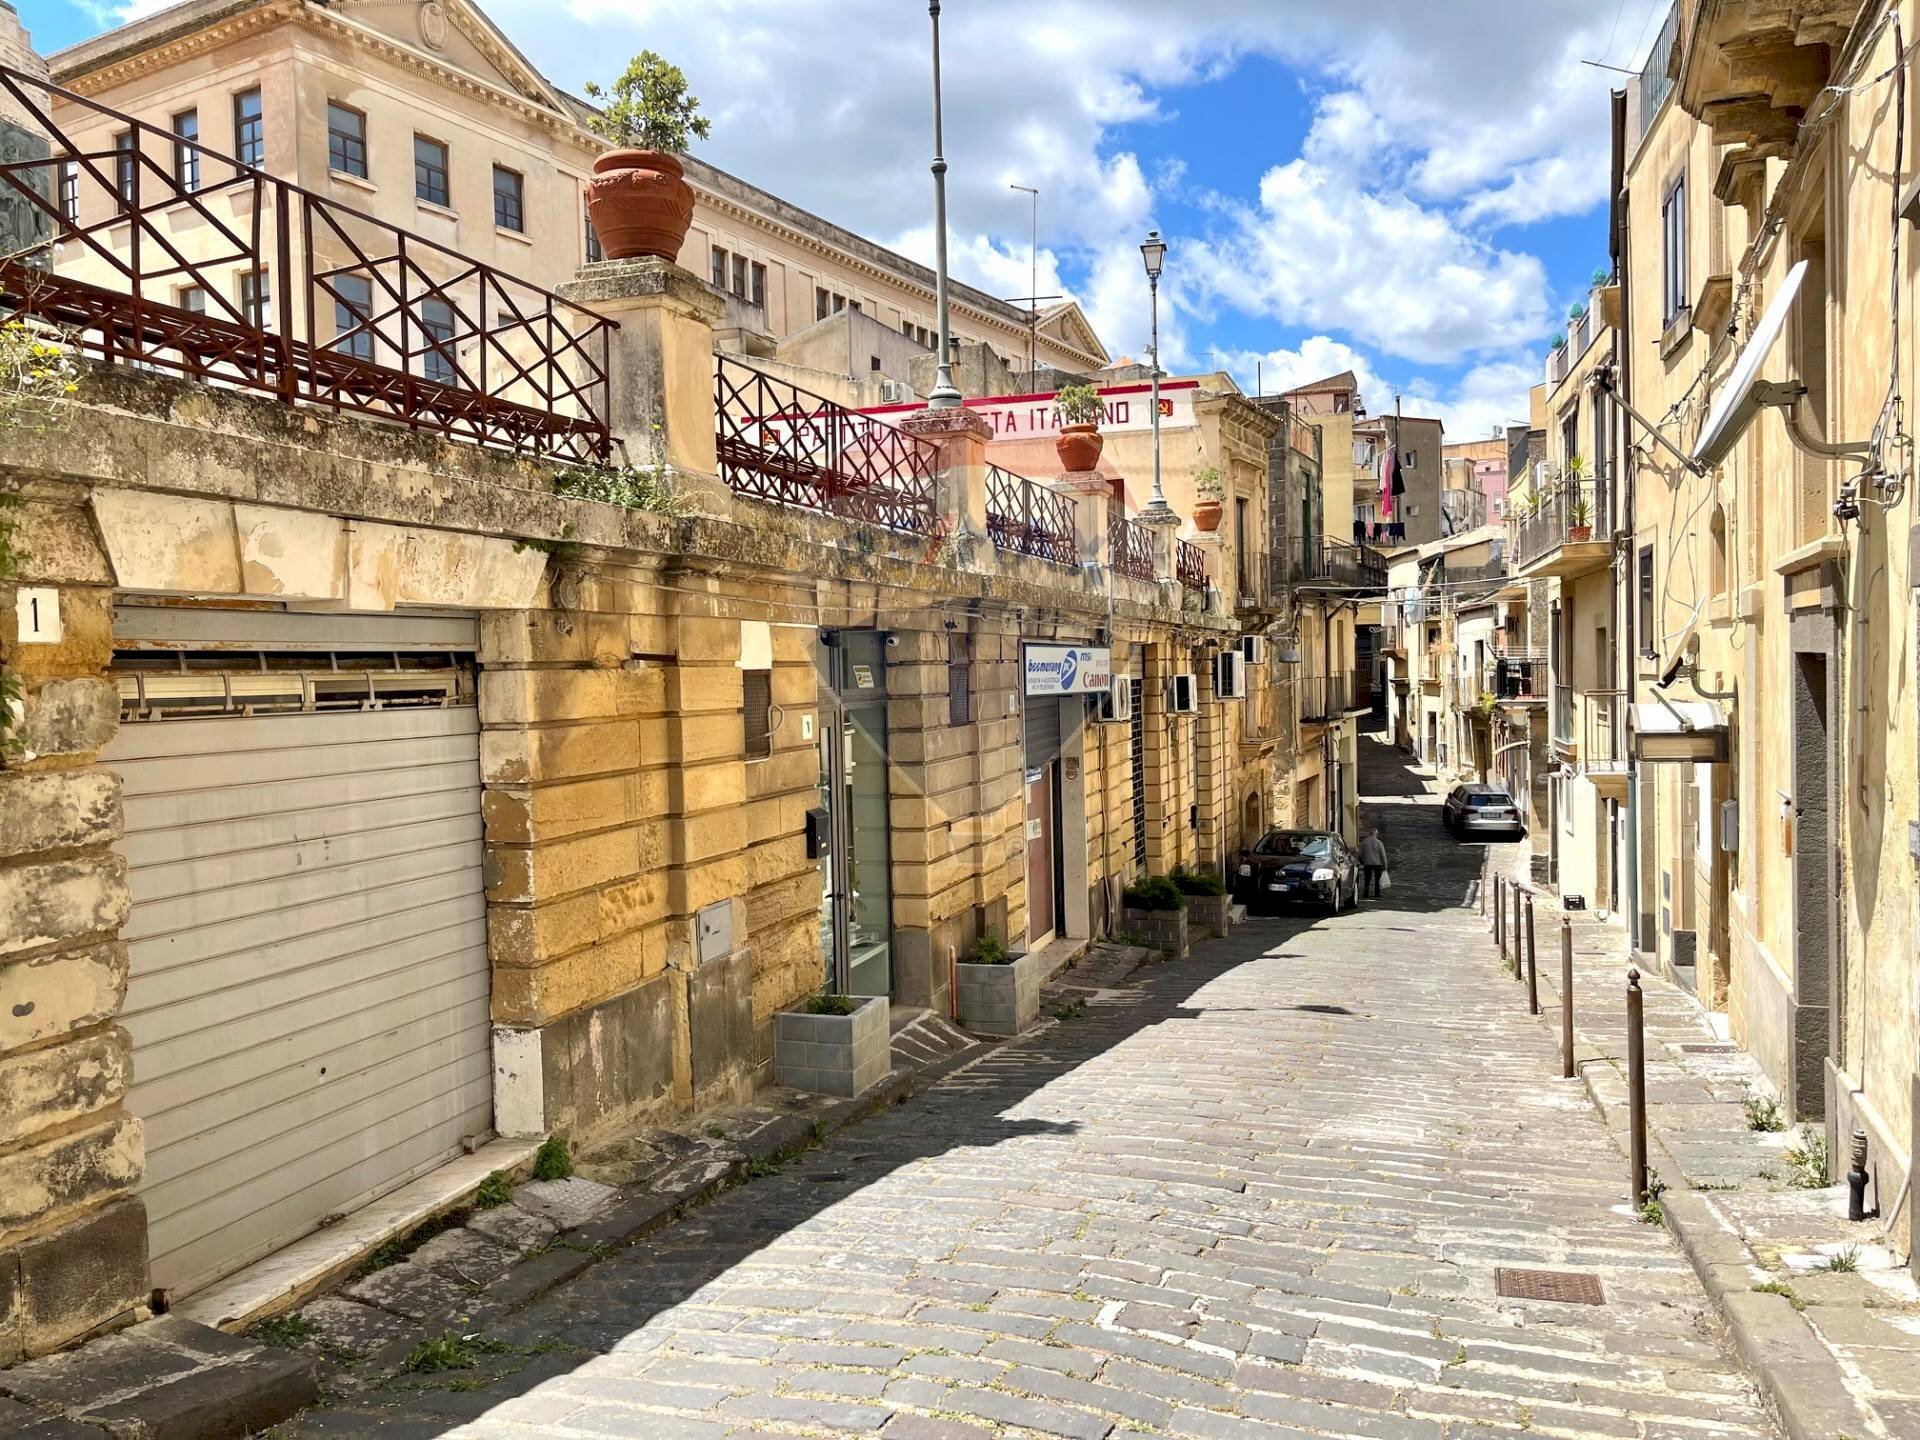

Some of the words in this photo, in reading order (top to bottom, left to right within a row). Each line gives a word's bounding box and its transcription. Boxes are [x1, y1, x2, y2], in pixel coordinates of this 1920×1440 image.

[799, 421, 882, 447] PATITO
[1030, 401, 1129, 430] ITAANO
[31, 597, 39, 632] 1
[1028, 659, 1061, 675] boomerang
[1082, 672, 1109, 688] Canon
